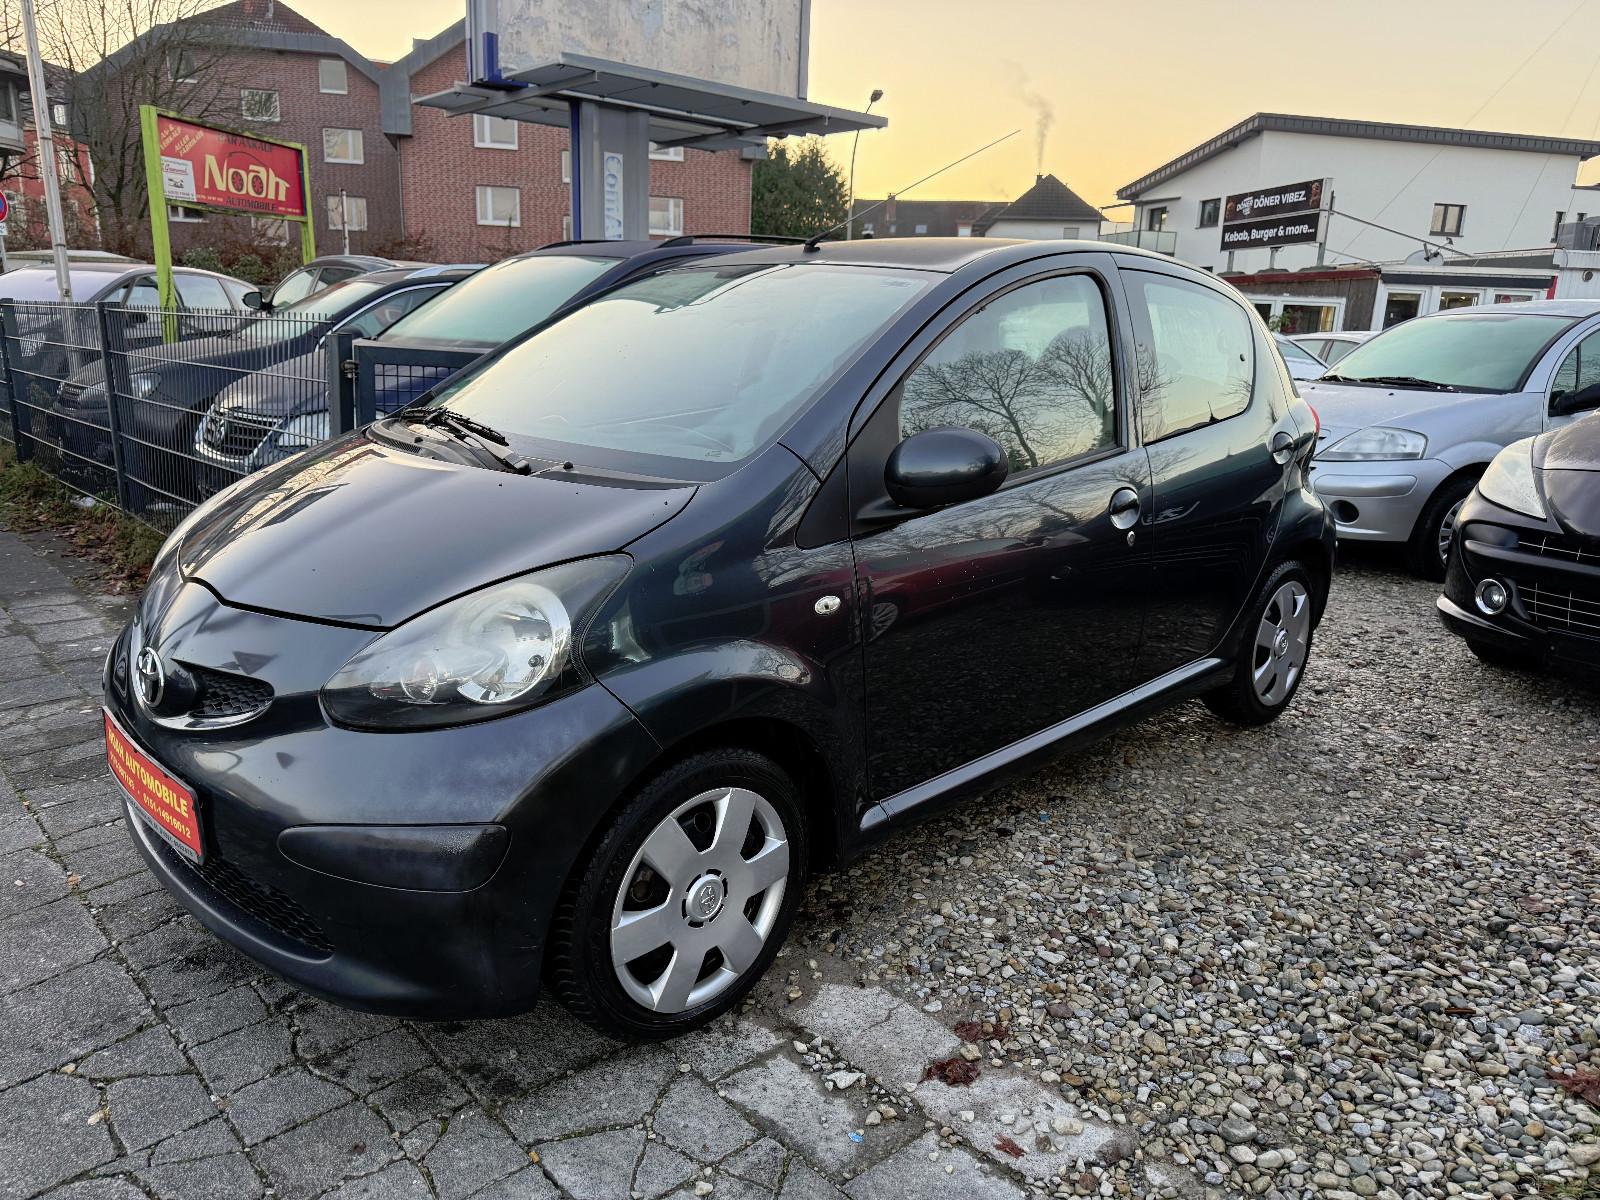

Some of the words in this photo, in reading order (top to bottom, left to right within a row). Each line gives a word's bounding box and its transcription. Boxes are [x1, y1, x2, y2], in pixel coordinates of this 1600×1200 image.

[226, 197, 276, 211] AUTOMOBILE
[1253, 195, 1280, 208] DÖNER
[1224, 229, 1250, 242] Kebab,
[1250, 227, 1277, 241] Burger
[1277, 225, 1285, 236] &
[125, 751, 189, 819] AUTOMOBILE
